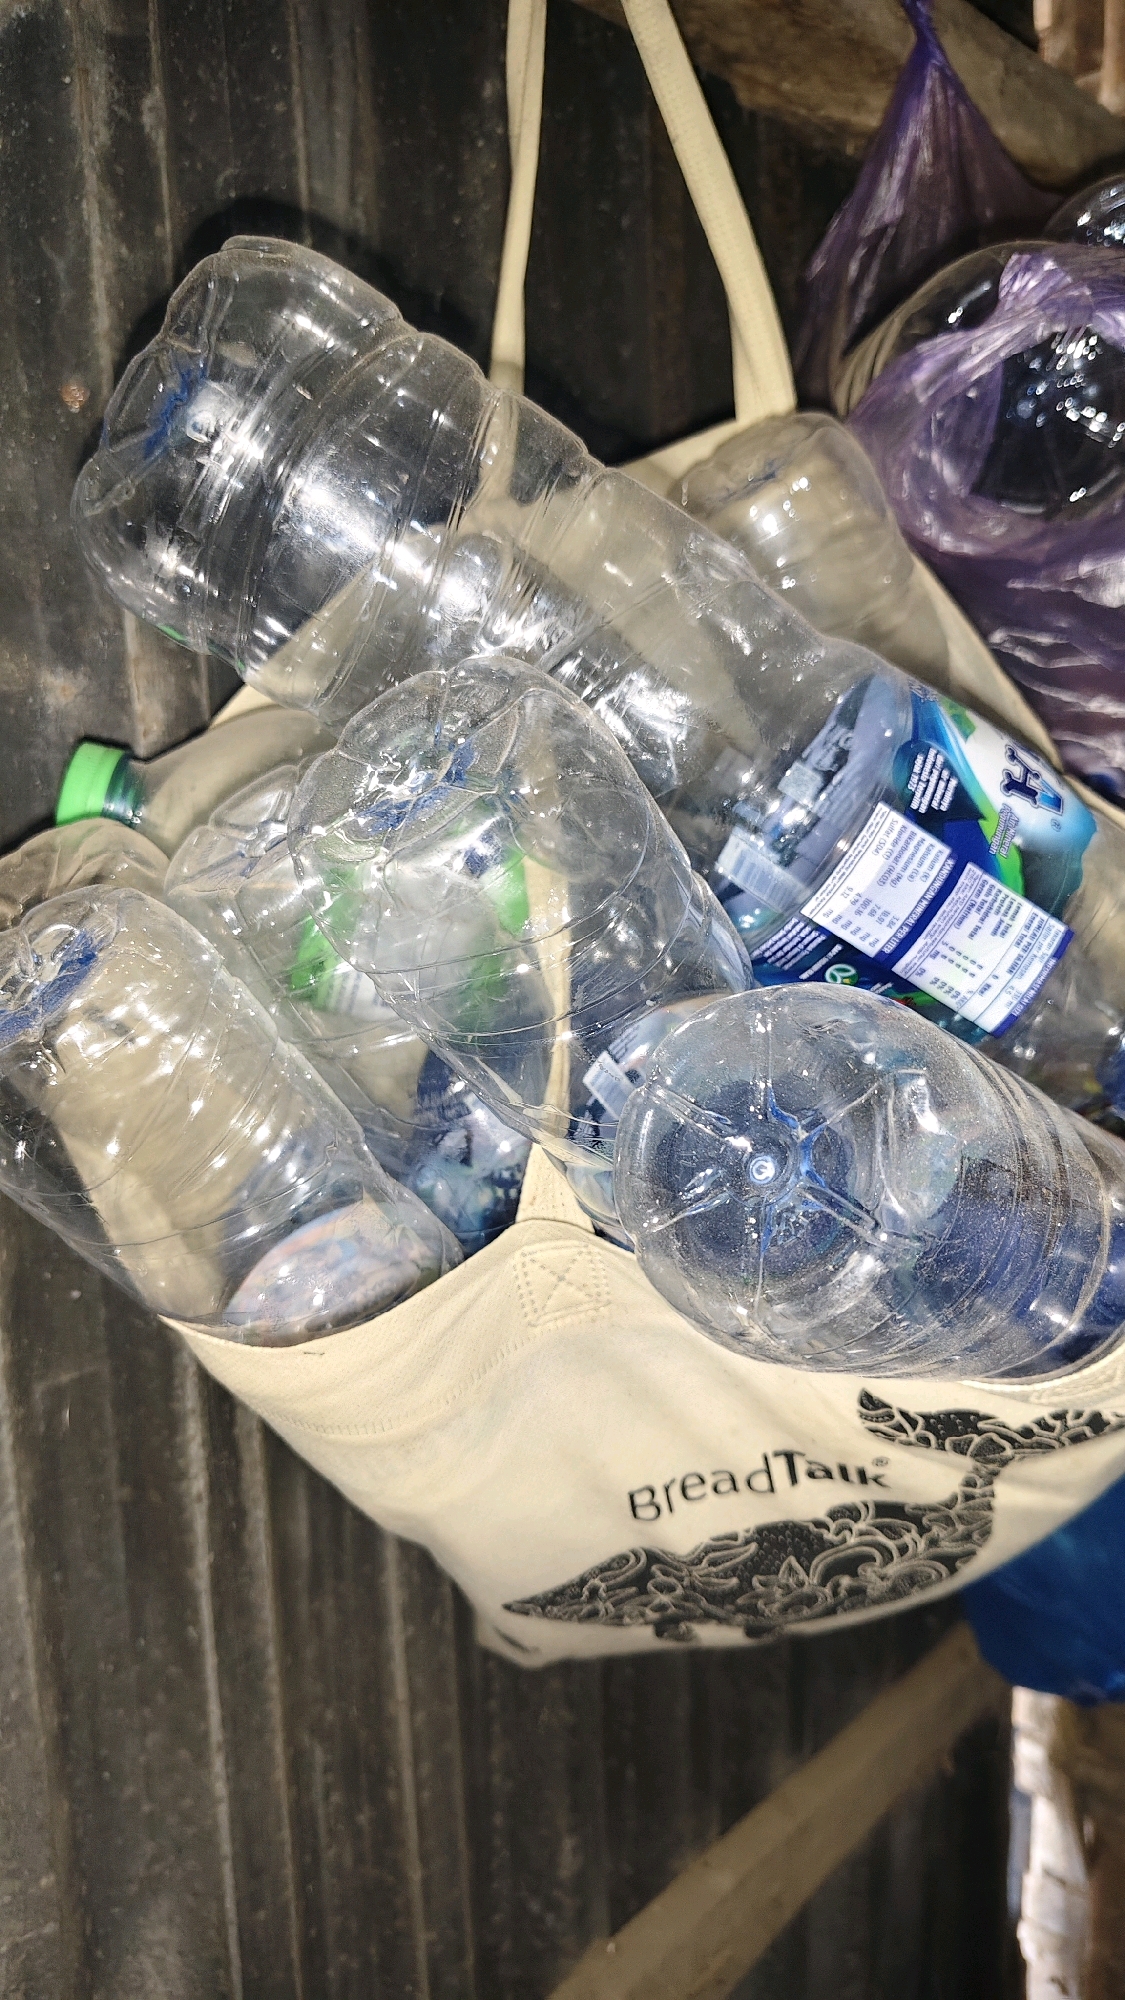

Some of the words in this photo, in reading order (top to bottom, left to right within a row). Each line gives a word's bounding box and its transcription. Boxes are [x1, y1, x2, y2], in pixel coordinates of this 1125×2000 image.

[883, 818, 898, 838] Sulfat
[1007, 813, 1019, 829] Air
[890, 824, 907, 848] Klorida
[998, 826, 1015, 859] Mineral
[892, 830, 916, 865] Bikarbonat
[899, 836, 925, 873] Magnesium
[915, 842, 934, 869] Kalsium
[926, 848, 943, 872] Kalium
[888, 871, 903, 889] (Mg)
[906, 867, 919, 883] (Ca)
[920, 871, 930, 883] (K)
[923, 859, 953, 901] KANDUNGAN
[903, 898, 928, 927] MINERAL
[974, 897, 987, 915] Total
[993, 893, 1009, 916] Protein
[894, 924, 908, 939] PER
[967, 923, 981, 940] Total
[998, 921, 1011, 938] Total
[881, 936, 898, 954] LITER
[1013, 931, 1027, 949] Total
[1010, 1002, 1023, 1017] GIZI
